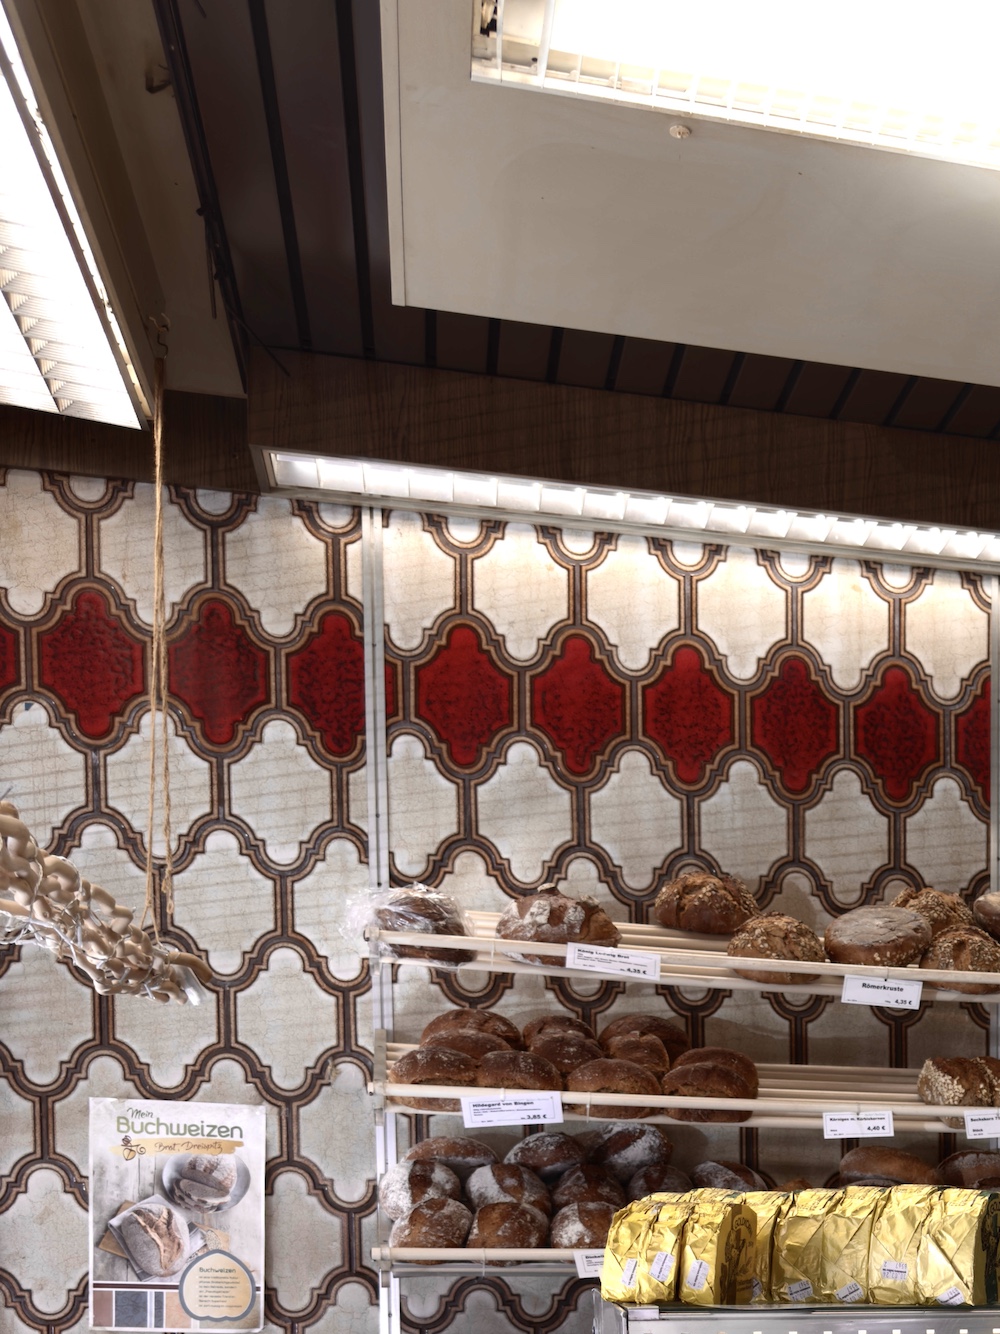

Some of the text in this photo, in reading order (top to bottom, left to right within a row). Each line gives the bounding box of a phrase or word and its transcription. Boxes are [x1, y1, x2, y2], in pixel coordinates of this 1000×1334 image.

[861, 982, 904, 992] Römerkruste
[126, 1107, 154, 1119] Mein
[116, 1116, 243, 1139] Buchweizen
